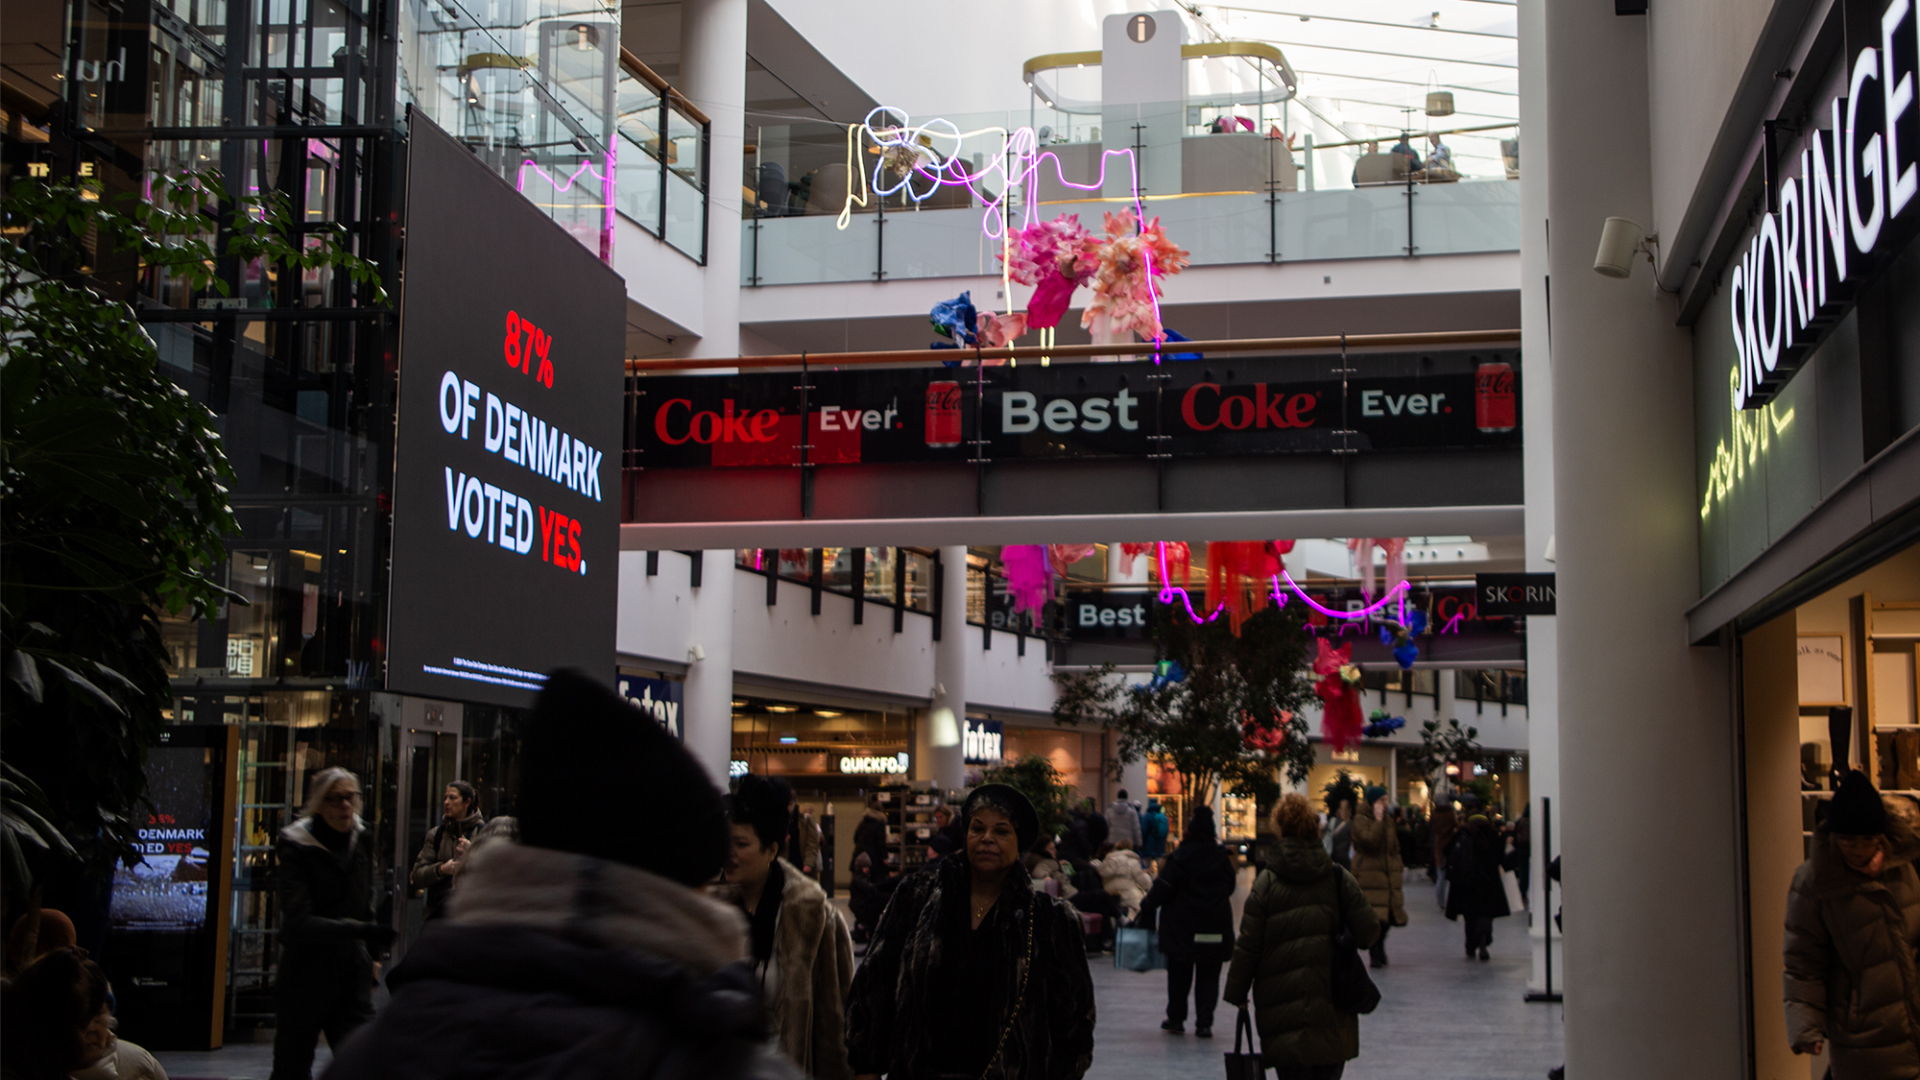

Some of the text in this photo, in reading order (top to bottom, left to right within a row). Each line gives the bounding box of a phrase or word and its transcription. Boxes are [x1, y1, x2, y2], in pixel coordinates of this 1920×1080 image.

[1731, 0, 1920, 411] SKORINGE
[504, 310, 554, 389] 87%
[654, 398, 904, 445] Coke Ever.
[1002, 382, 1452, 433] Best Coke Ever.
[439, 370, 603, 502] OF DENMARK
[445, 466, 587, 576] VOTED YES.
[1078, 603, 1146, 627] Best
[1346, 598, 1417, 624] Best
[138, 828, 205, 840] DENMARK
[167, 842, 192, 854] YES
